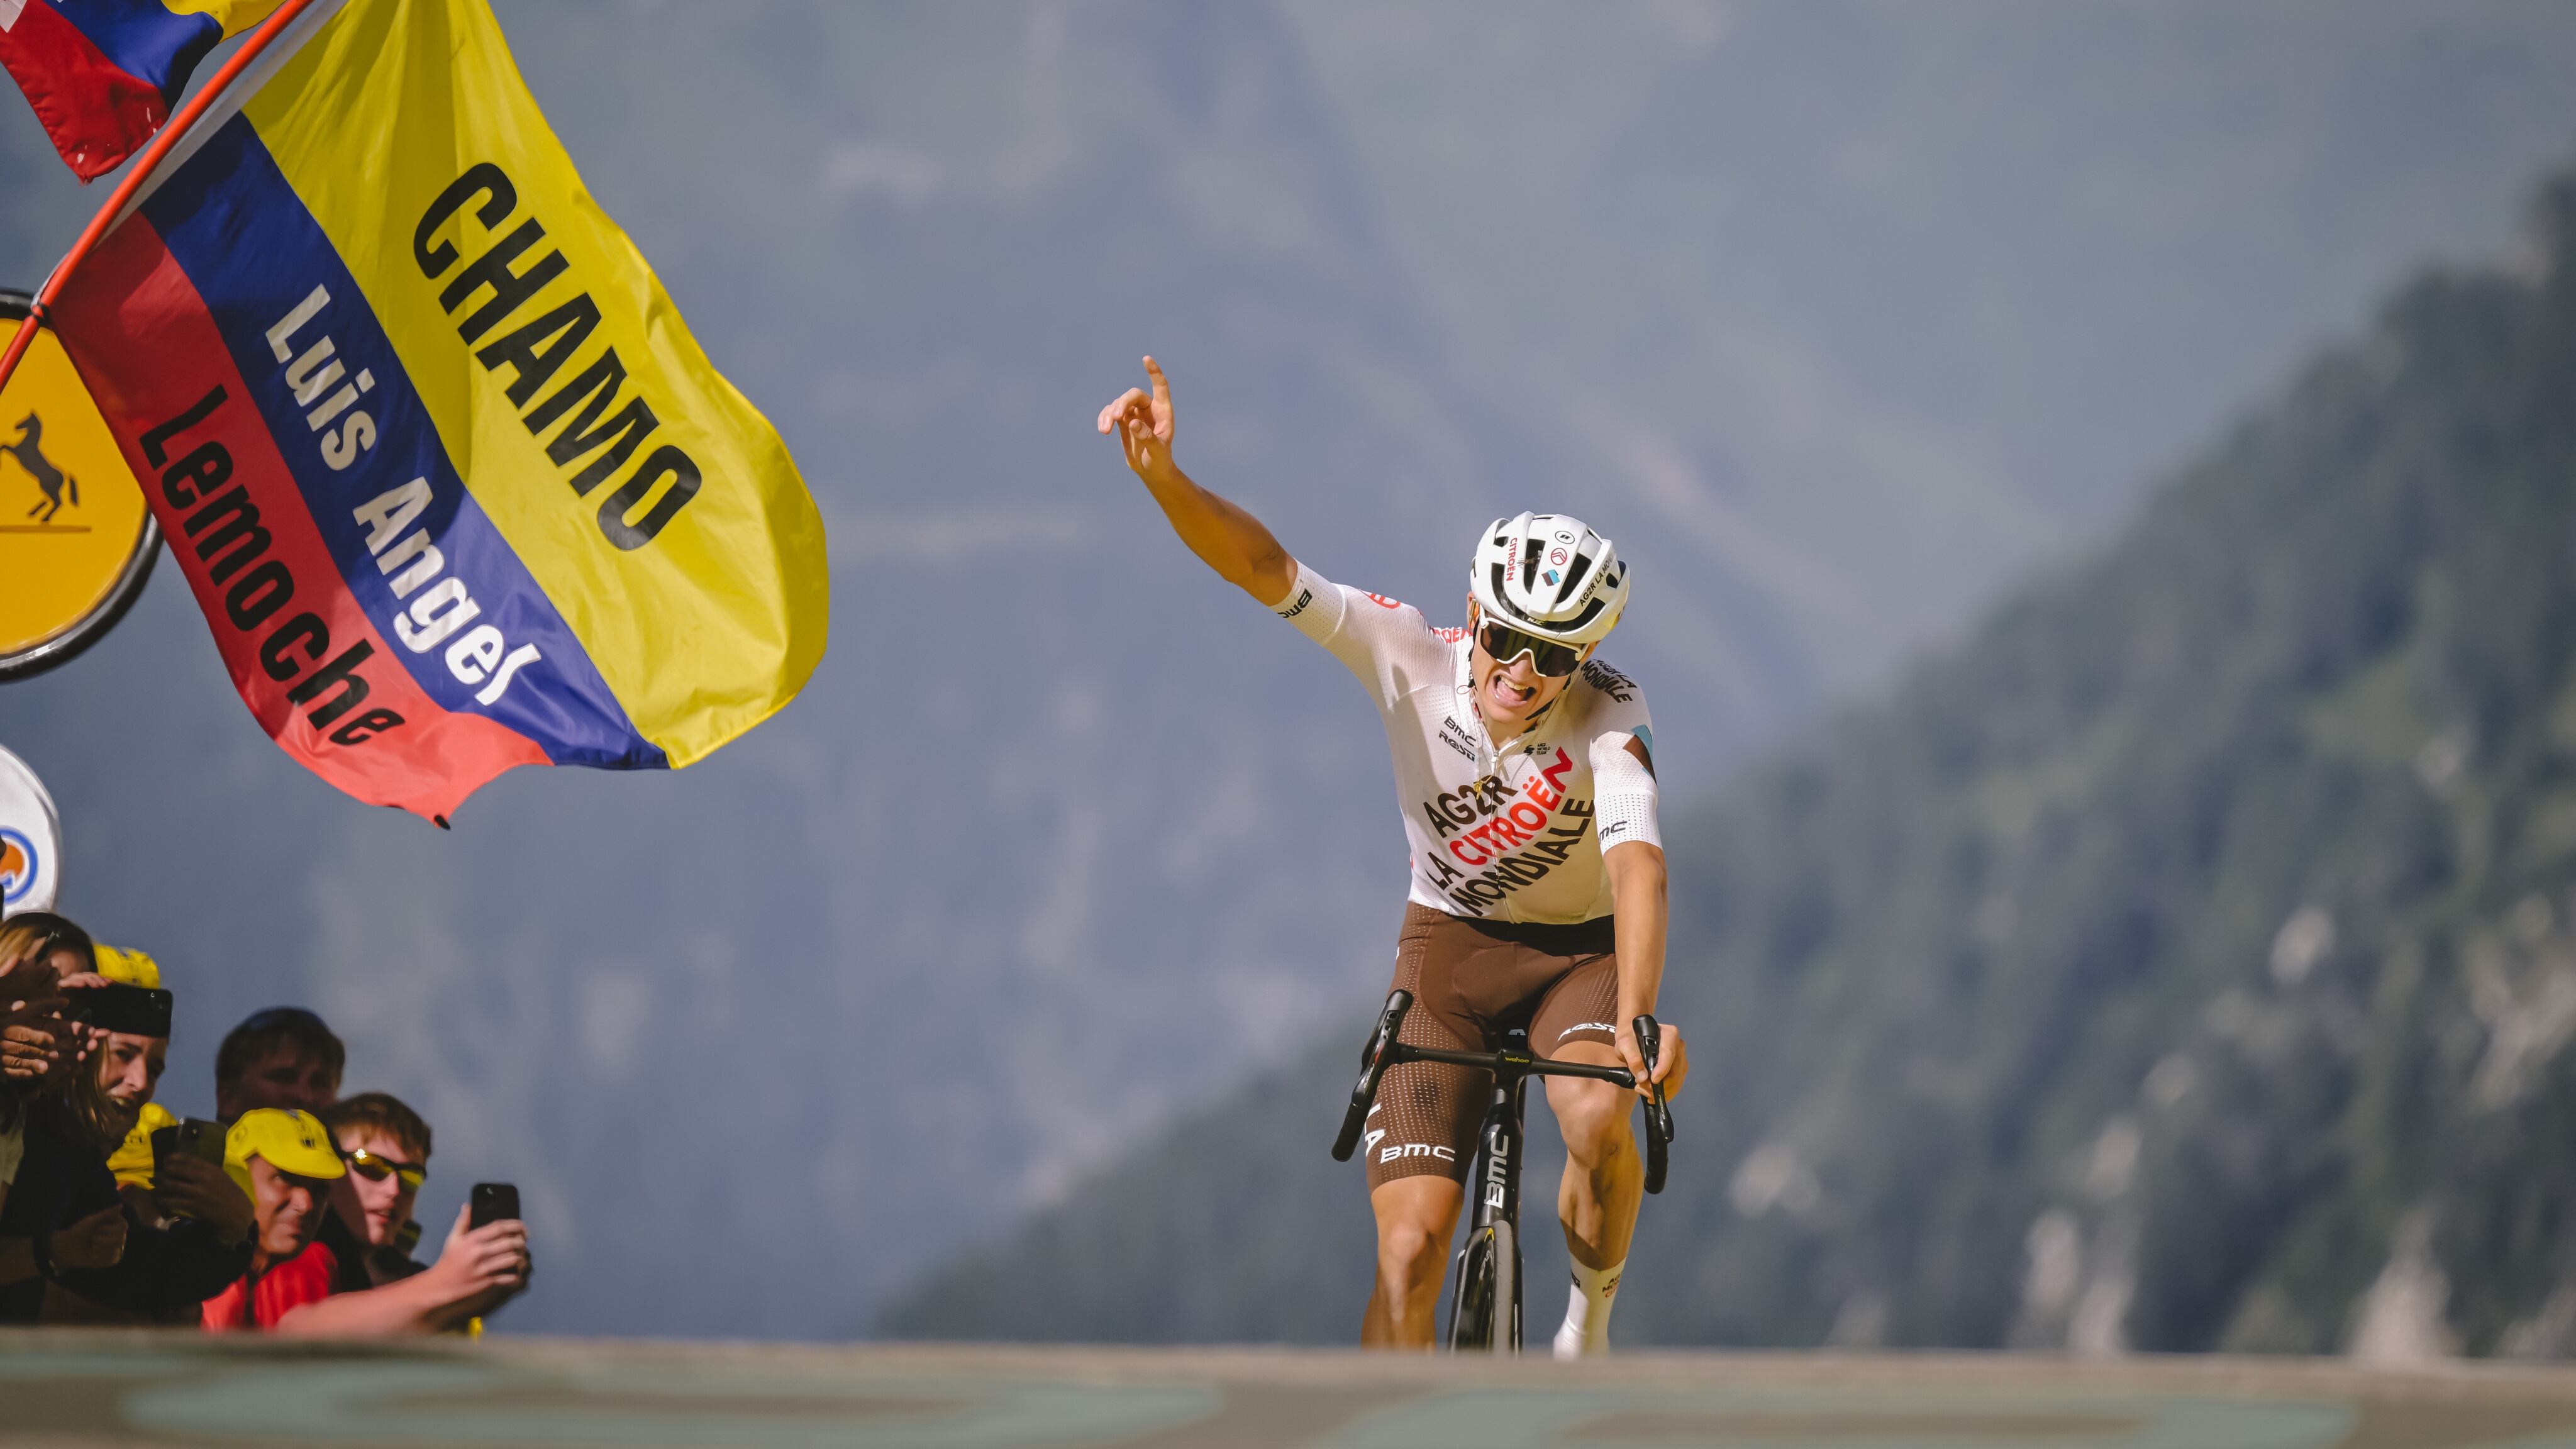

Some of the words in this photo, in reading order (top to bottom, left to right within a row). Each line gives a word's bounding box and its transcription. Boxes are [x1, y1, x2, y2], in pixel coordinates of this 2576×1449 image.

[413, 162, 702, 551] CHAMO
[265, 283, 377, 470] Luis
[353, 476, 541, 706] Angel
[1506, 537, 1518, 582] CITROËN
[1579, 582, 1596, 607] AG2R
[1595, 572, 1604, 584] LA
[1580, 660, 1633, 703] MONDIALE
[1444, 716, 1477, 747] BMC
[1423, 774, 1518, 838] AG2R
[1450, 746, 1573, 866] CITROËN
[1426, 852, 1465, 891] LA
[1449, 797, 1595, 917] MONDIALE
[1380, 1143, 1456, 1163] BMC
[1484, 1131, 1509, 1209] BMC
